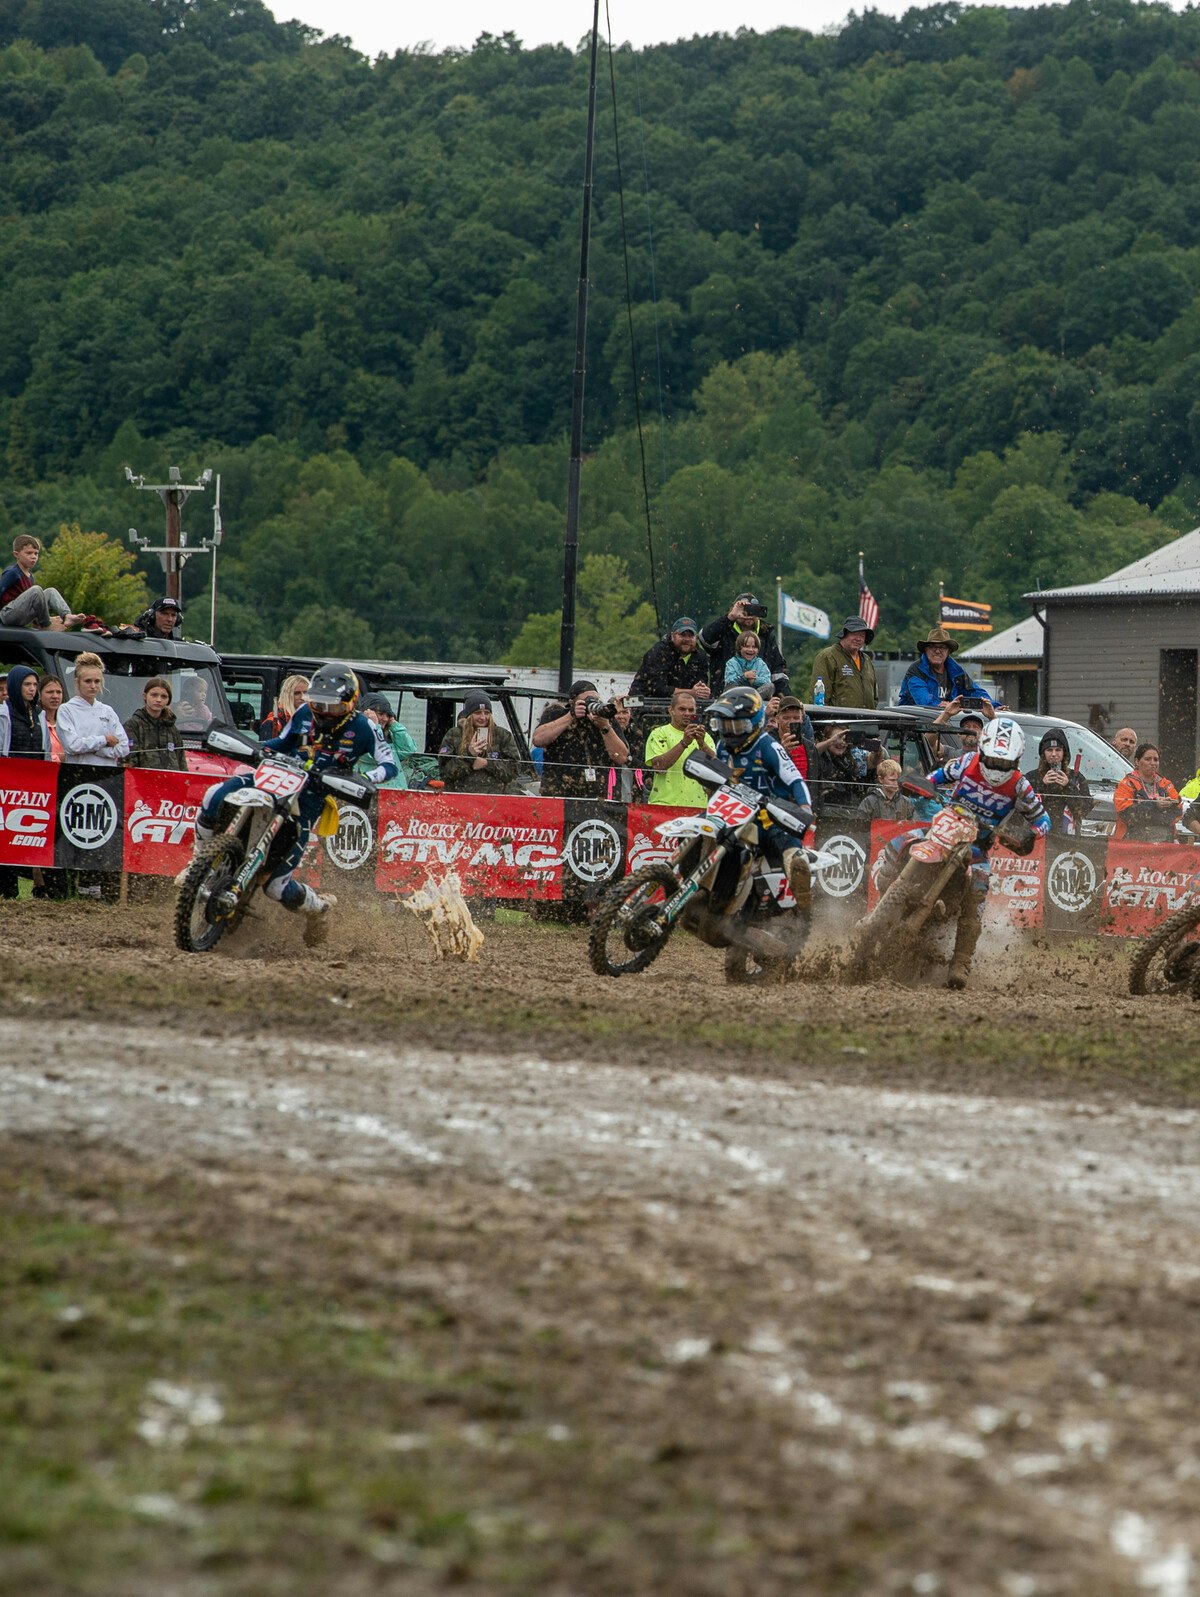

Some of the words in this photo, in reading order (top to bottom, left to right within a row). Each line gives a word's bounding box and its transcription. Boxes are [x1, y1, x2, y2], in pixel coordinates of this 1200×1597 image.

[255, 766, 302, 796] 739
[962, 776, 1012, 810] FXR
[156, 799, 203, 819] ROC
[708, 793, 752, 826] 342
[959, 797, 994, 818] MOTO
[406, 819, 456, 839] ROCKY
[462, 822, 558, 843] MOUNTAIN
